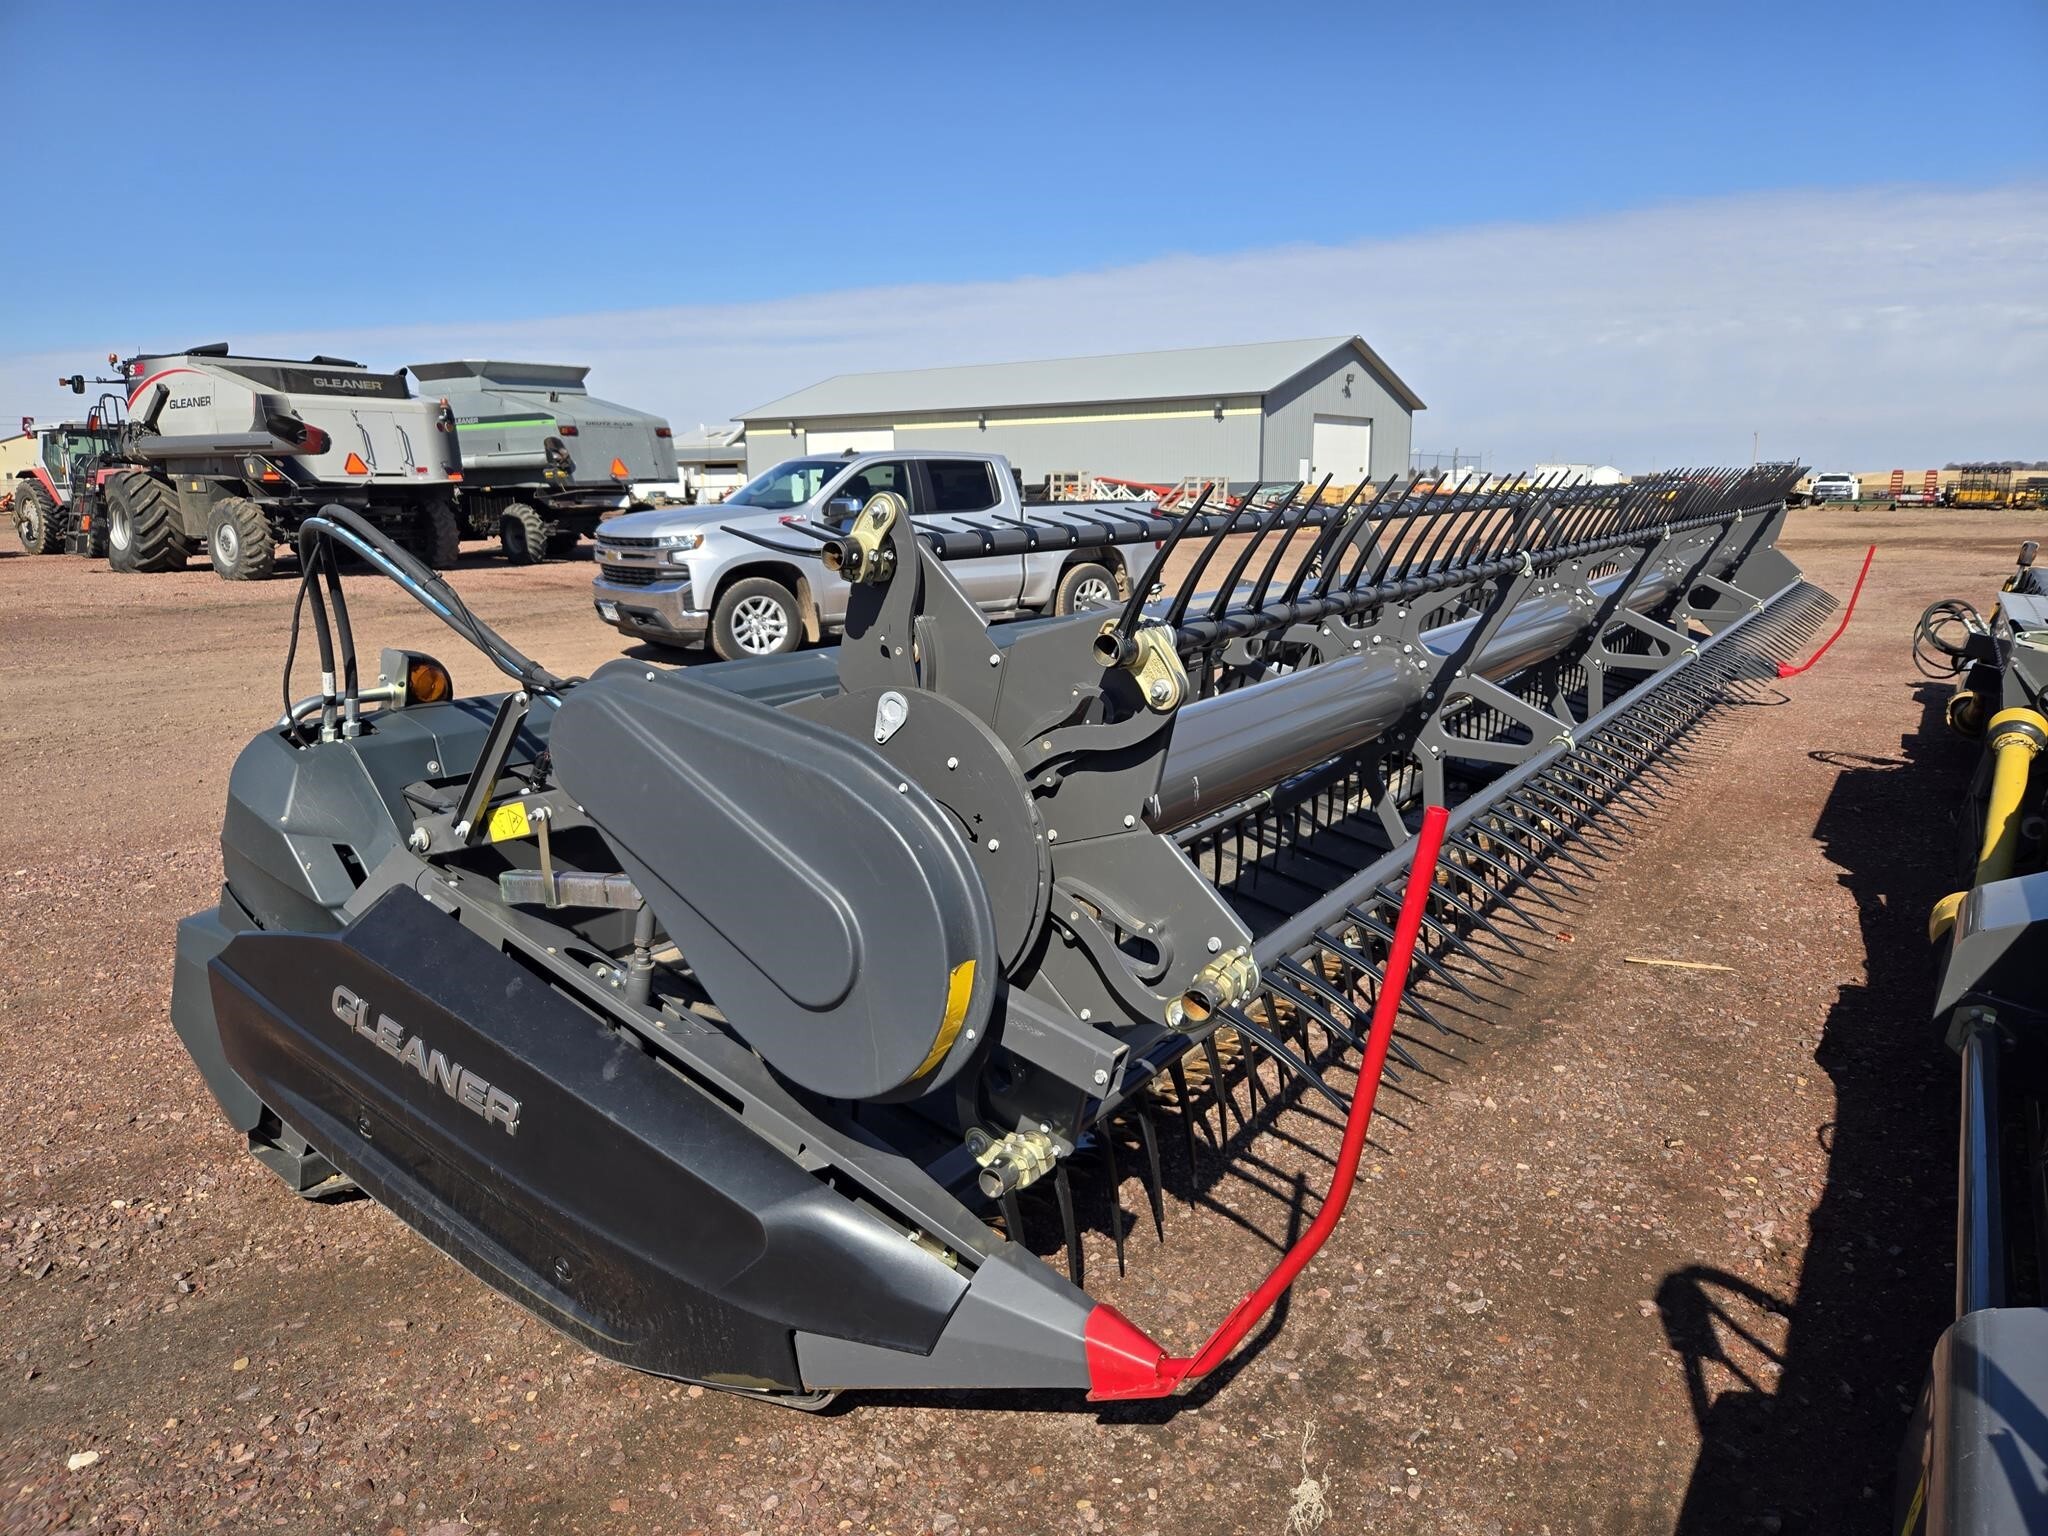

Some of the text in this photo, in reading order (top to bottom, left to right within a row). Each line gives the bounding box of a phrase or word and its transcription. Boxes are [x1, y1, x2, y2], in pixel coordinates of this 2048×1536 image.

[312, 377, 383, 390] GLEANER
[169, 396, 211, 410] GLEANER
[331, 984, 522, 1137] GLEANER
